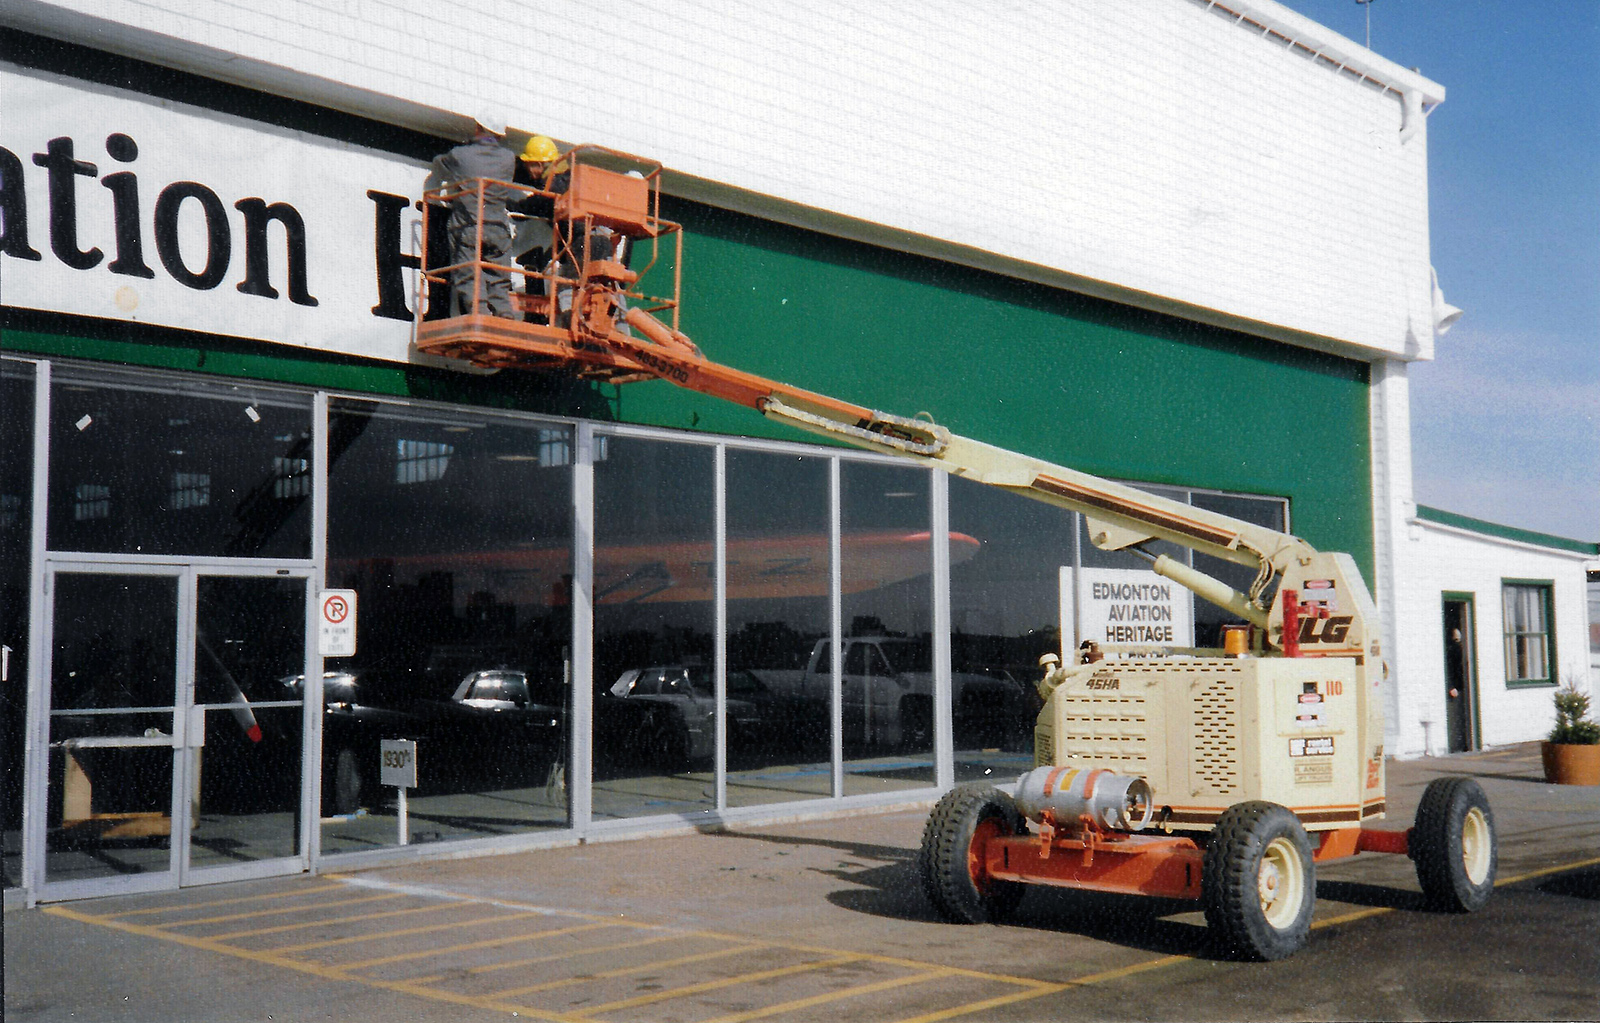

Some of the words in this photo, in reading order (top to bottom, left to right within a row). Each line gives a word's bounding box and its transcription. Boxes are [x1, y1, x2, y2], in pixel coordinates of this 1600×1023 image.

[1092, 582, 1171, 601] EDMONTON
[1108, 604, 1172, 621] AVIATION
[1105, 625, 1173, 642] HERITAGE
